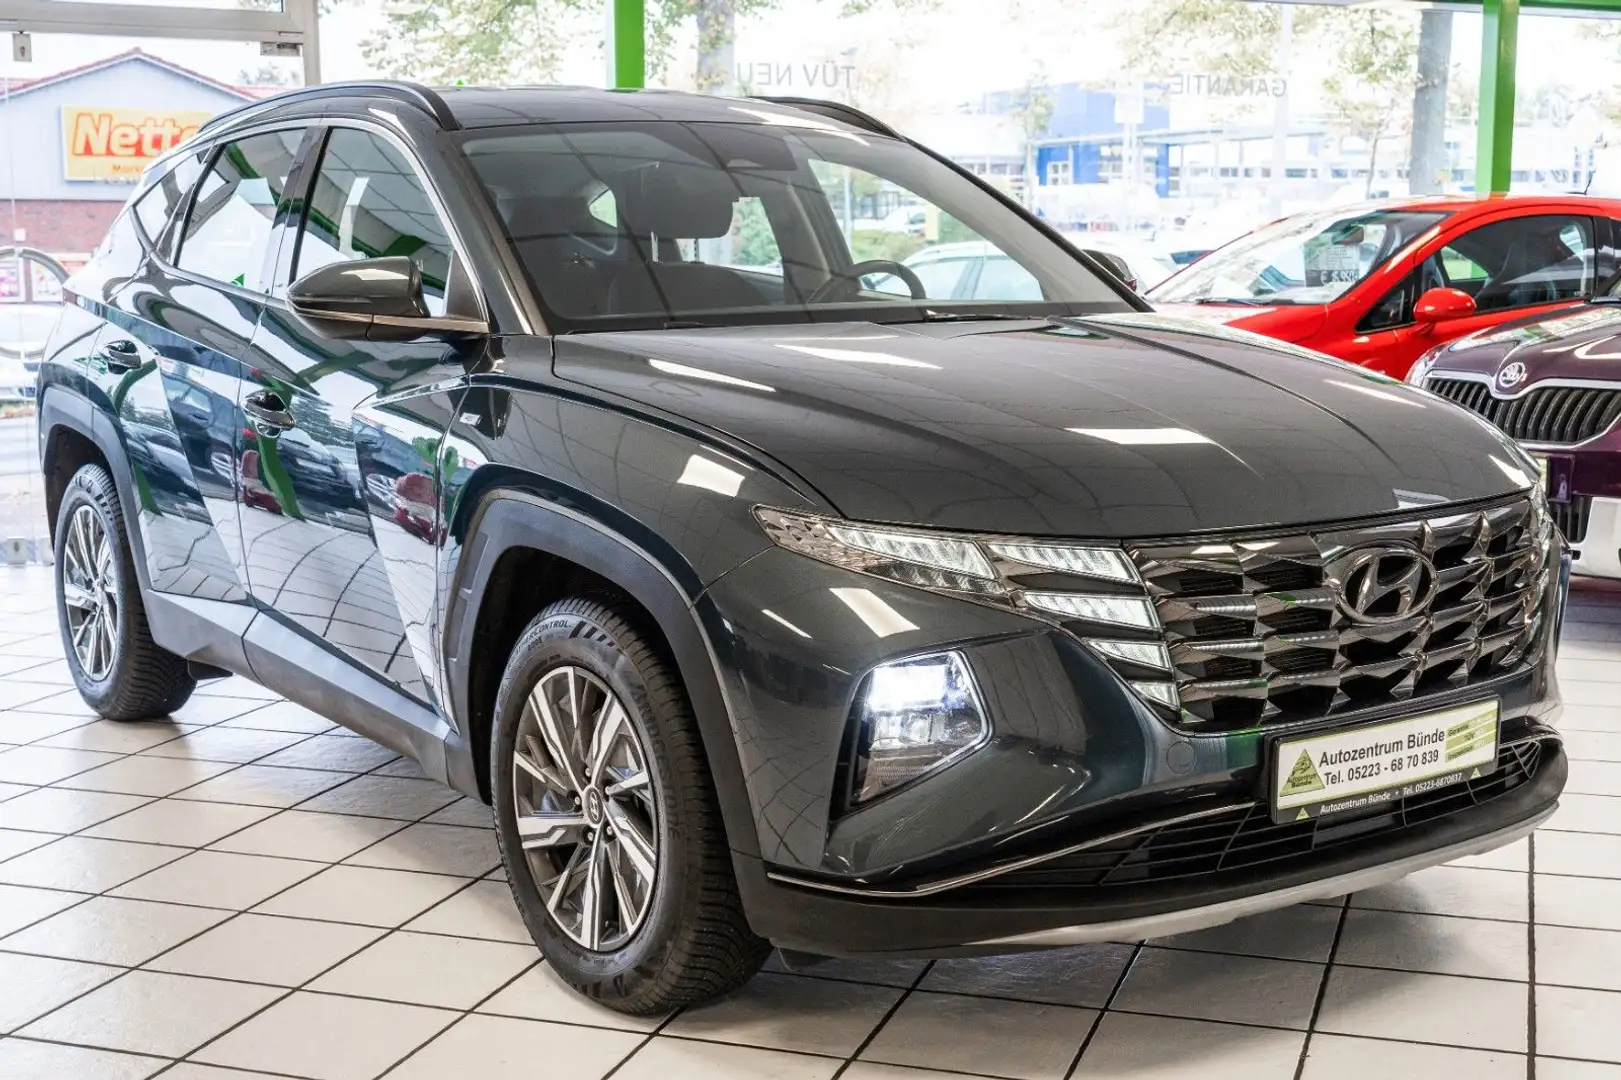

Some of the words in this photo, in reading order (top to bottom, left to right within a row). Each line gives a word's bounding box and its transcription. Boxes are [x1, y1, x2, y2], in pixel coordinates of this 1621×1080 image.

[1319, 740, 1403, 768] Autozentrum
[1407, 728, 1445, 749] Bünde
[1324, 770, 1344, 785] Tel.
[1347, 762, 1380, 781] 05223
[1390, 758, 1403, 772] 68
[1407, 754, 1418, 769] 70
[1421, 749, 1439, 765] 839
[1320, 798, 1367, 814] Autozentrum
[1368, 791, 1391, 803] Bünde
[1403, 786, 1414, 795] Tel.
